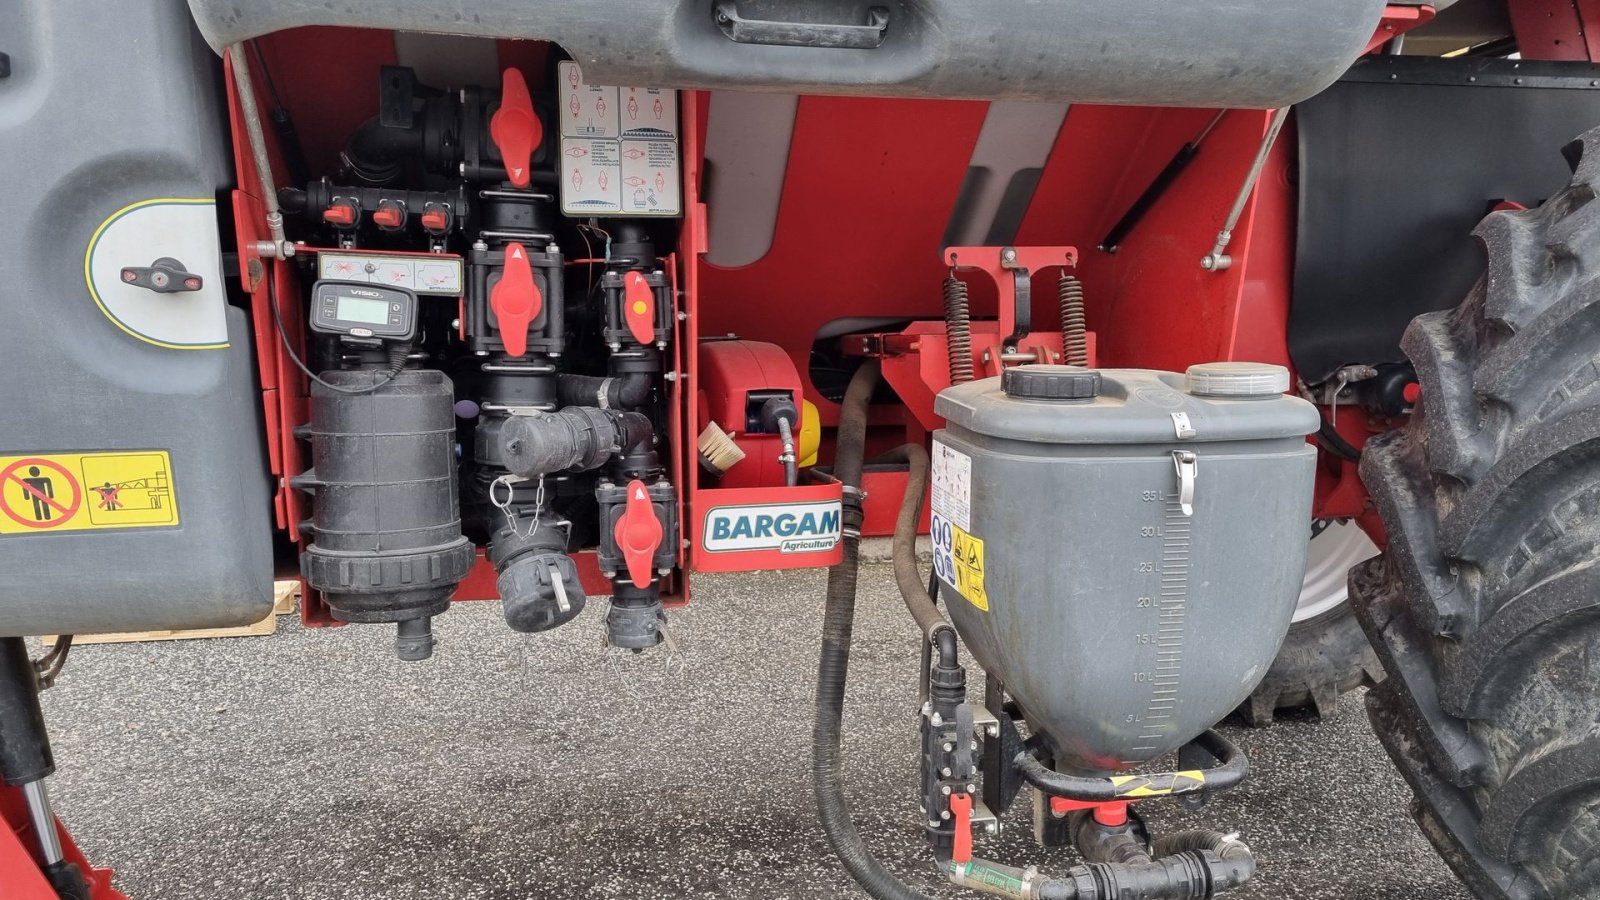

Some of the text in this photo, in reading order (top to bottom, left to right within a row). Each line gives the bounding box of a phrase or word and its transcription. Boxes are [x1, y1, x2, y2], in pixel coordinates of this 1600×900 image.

[350, 289, 379, 297] VISIO
[712, 510, 839, 540] BARGAM
[783, 540, 834, 551] Agriculture
